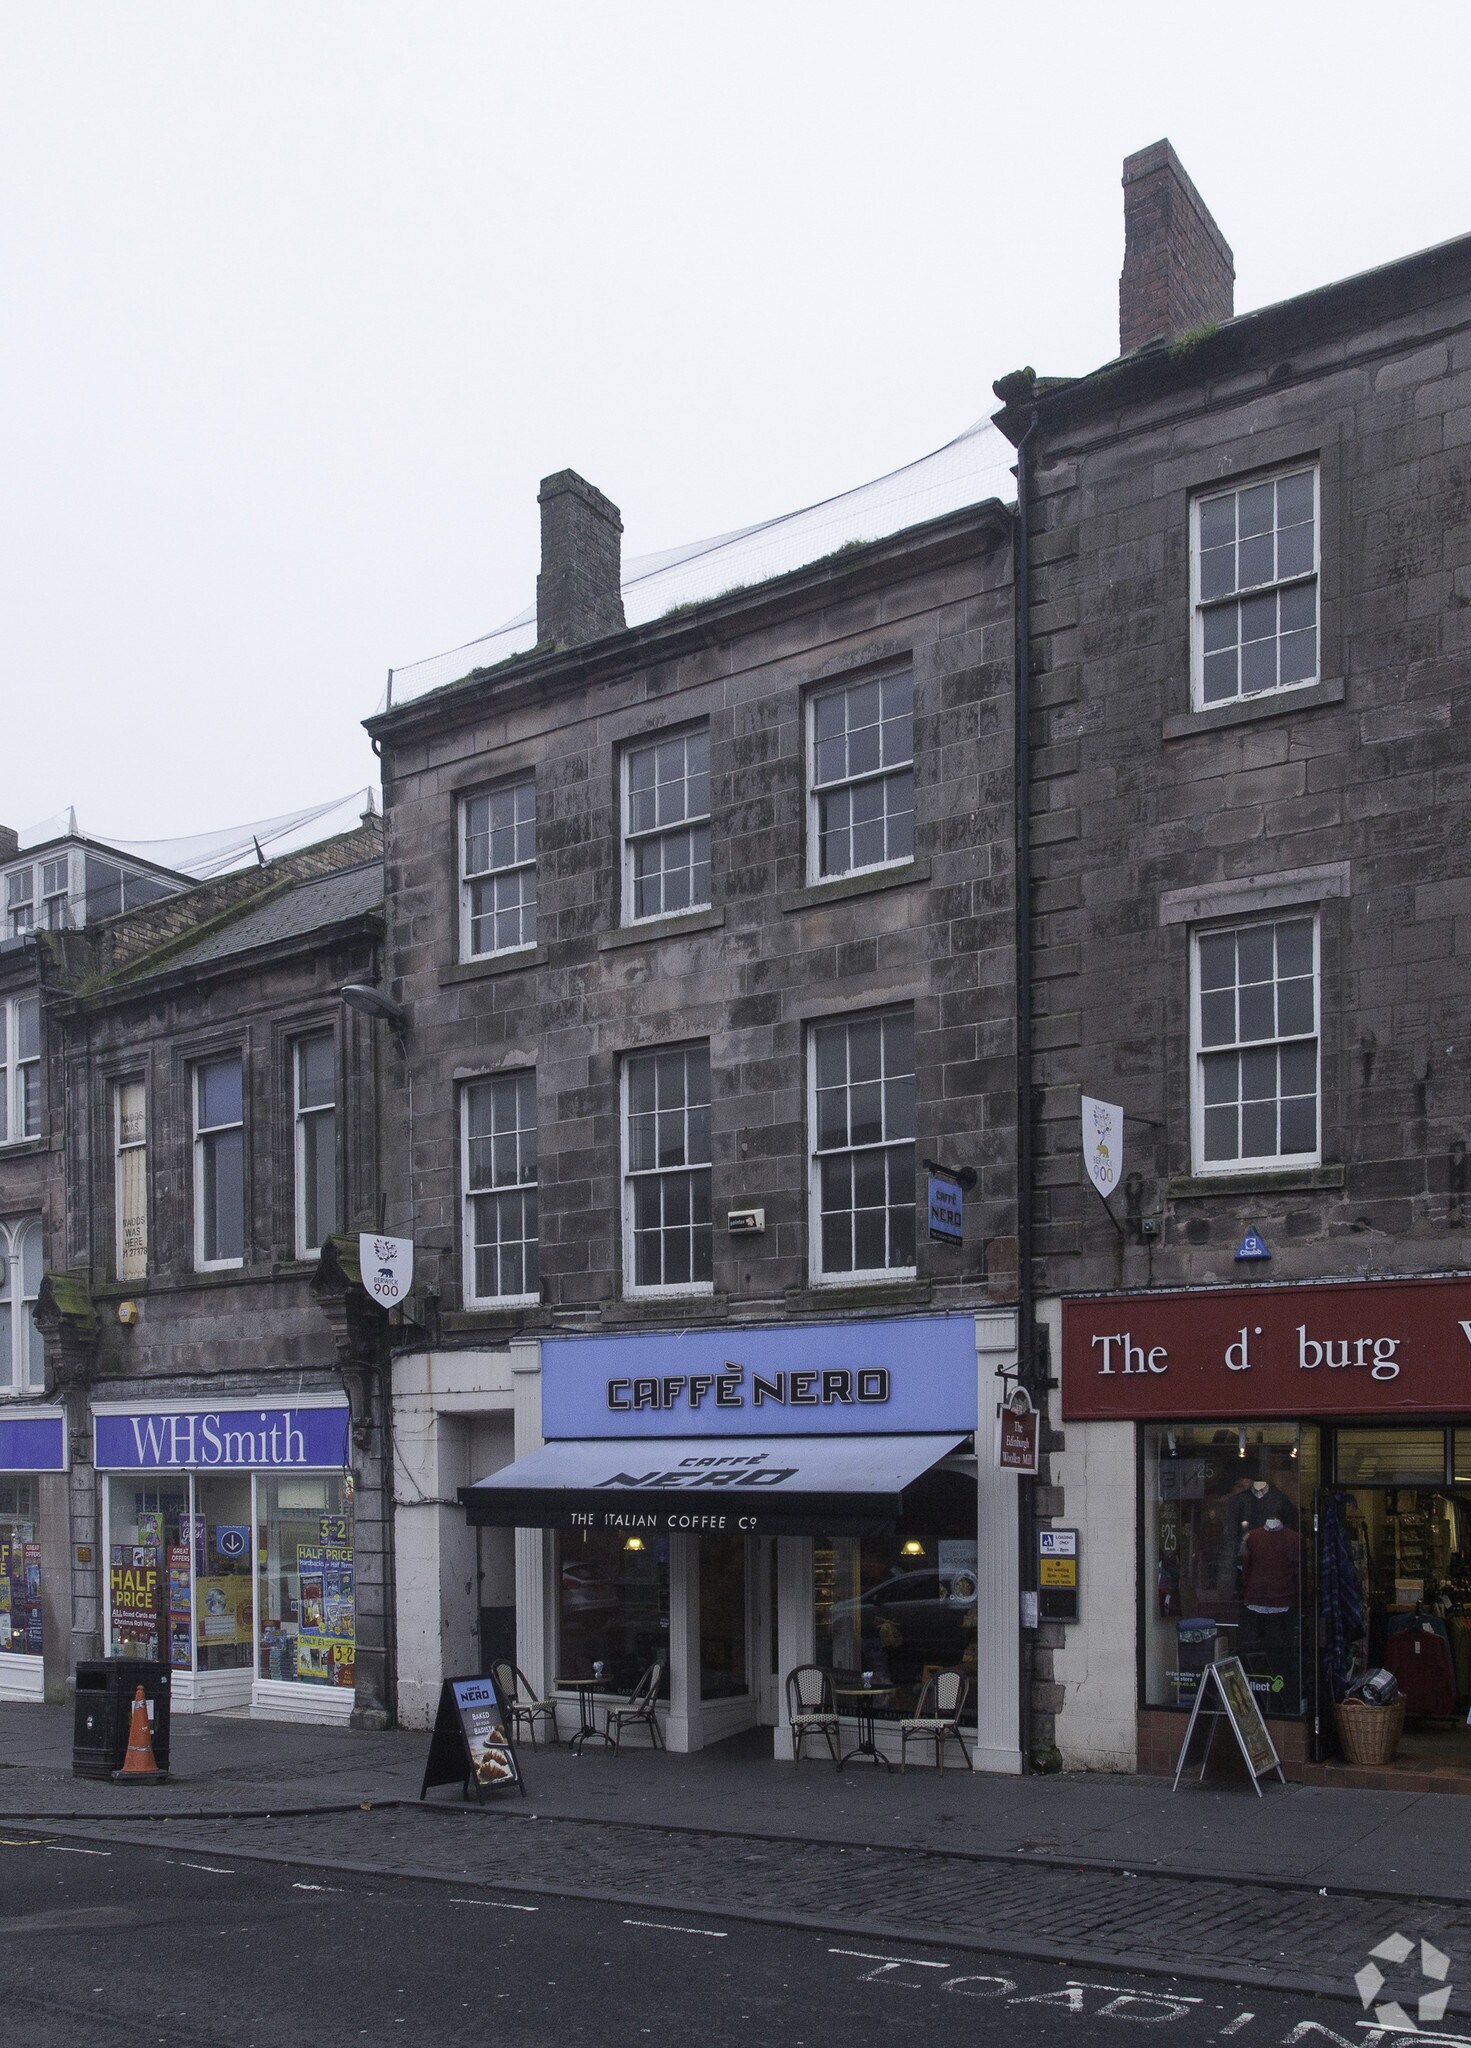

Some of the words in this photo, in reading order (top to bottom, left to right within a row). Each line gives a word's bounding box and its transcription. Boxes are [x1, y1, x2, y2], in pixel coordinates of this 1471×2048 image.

[1094, 1164, 1113, 1183] 900
[932, 1207, 962, 1228] NERO
[125, 1227, 140, 1237] WAS
[125, 1237, 142, 1248] HERE
[374, 1277, 399, 1286] BERWICK
[374, 1284, 399, 1297] 900
[1091, 1332, 1168, 1374] The
[752, 1367, 890, 1405] NERO
[1014, 1421, 1024, 1433] The
[130, 1412, 307, 1465] WHSmith
[1006, 1435, 1029, 1451] Edinburgh
[1002, 1451, 1020, 1464] Woollen
[593, 1468, 799, 1487] NERO
[320, 1519, 330, 1537] 3
[337, 1520, 346, 1538] 2
[571, 1513, 594, 1525] THE
[604, 1513, 657, 1527] ITALIAN
[667, 1515, 726, 1529] COFFEE
[173, 1547, 189, 1555] GREAT
[299, 1547, 323, 1559] HALF
[326, 1550, 353, 1561] PRICE
[111, 1569, 157, 1591] HALF
[116, 1591, 153, 1608] PRICE
[300, 1636, 316, 1645] ONLY
[460, 1690, 489, 1702] NERO
[472, 1711, 490, 1720] BAKED
